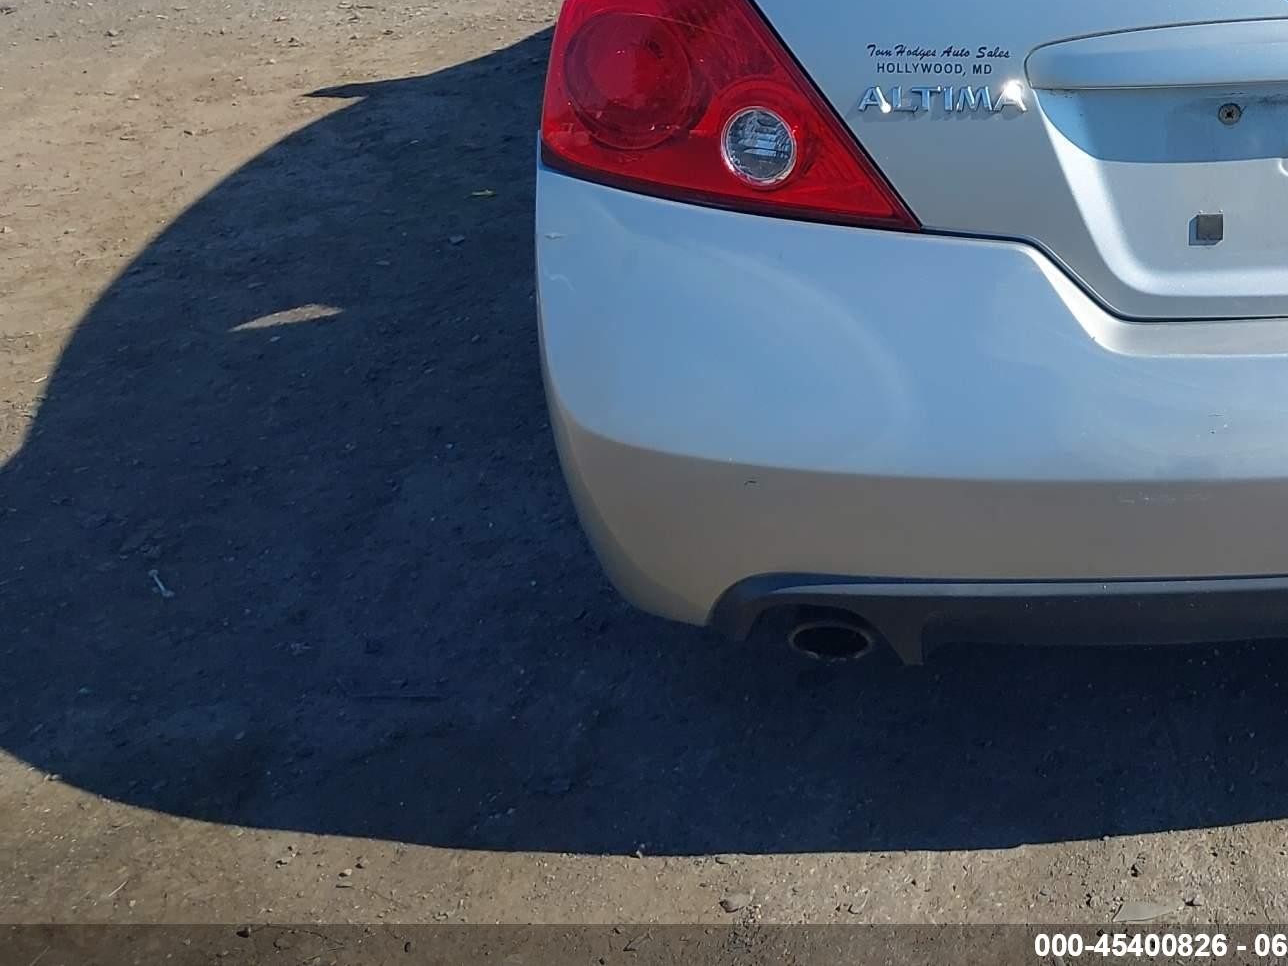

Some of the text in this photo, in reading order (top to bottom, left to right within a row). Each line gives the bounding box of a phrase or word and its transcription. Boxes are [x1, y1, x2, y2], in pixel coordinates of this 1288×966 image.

[866, 44, 1011, 60] Tom Hodges Auto Sales
[877, 62, 992, 76] HOLLYWOOD, MD
[858, 84, 1028, 113] ALTIMA
